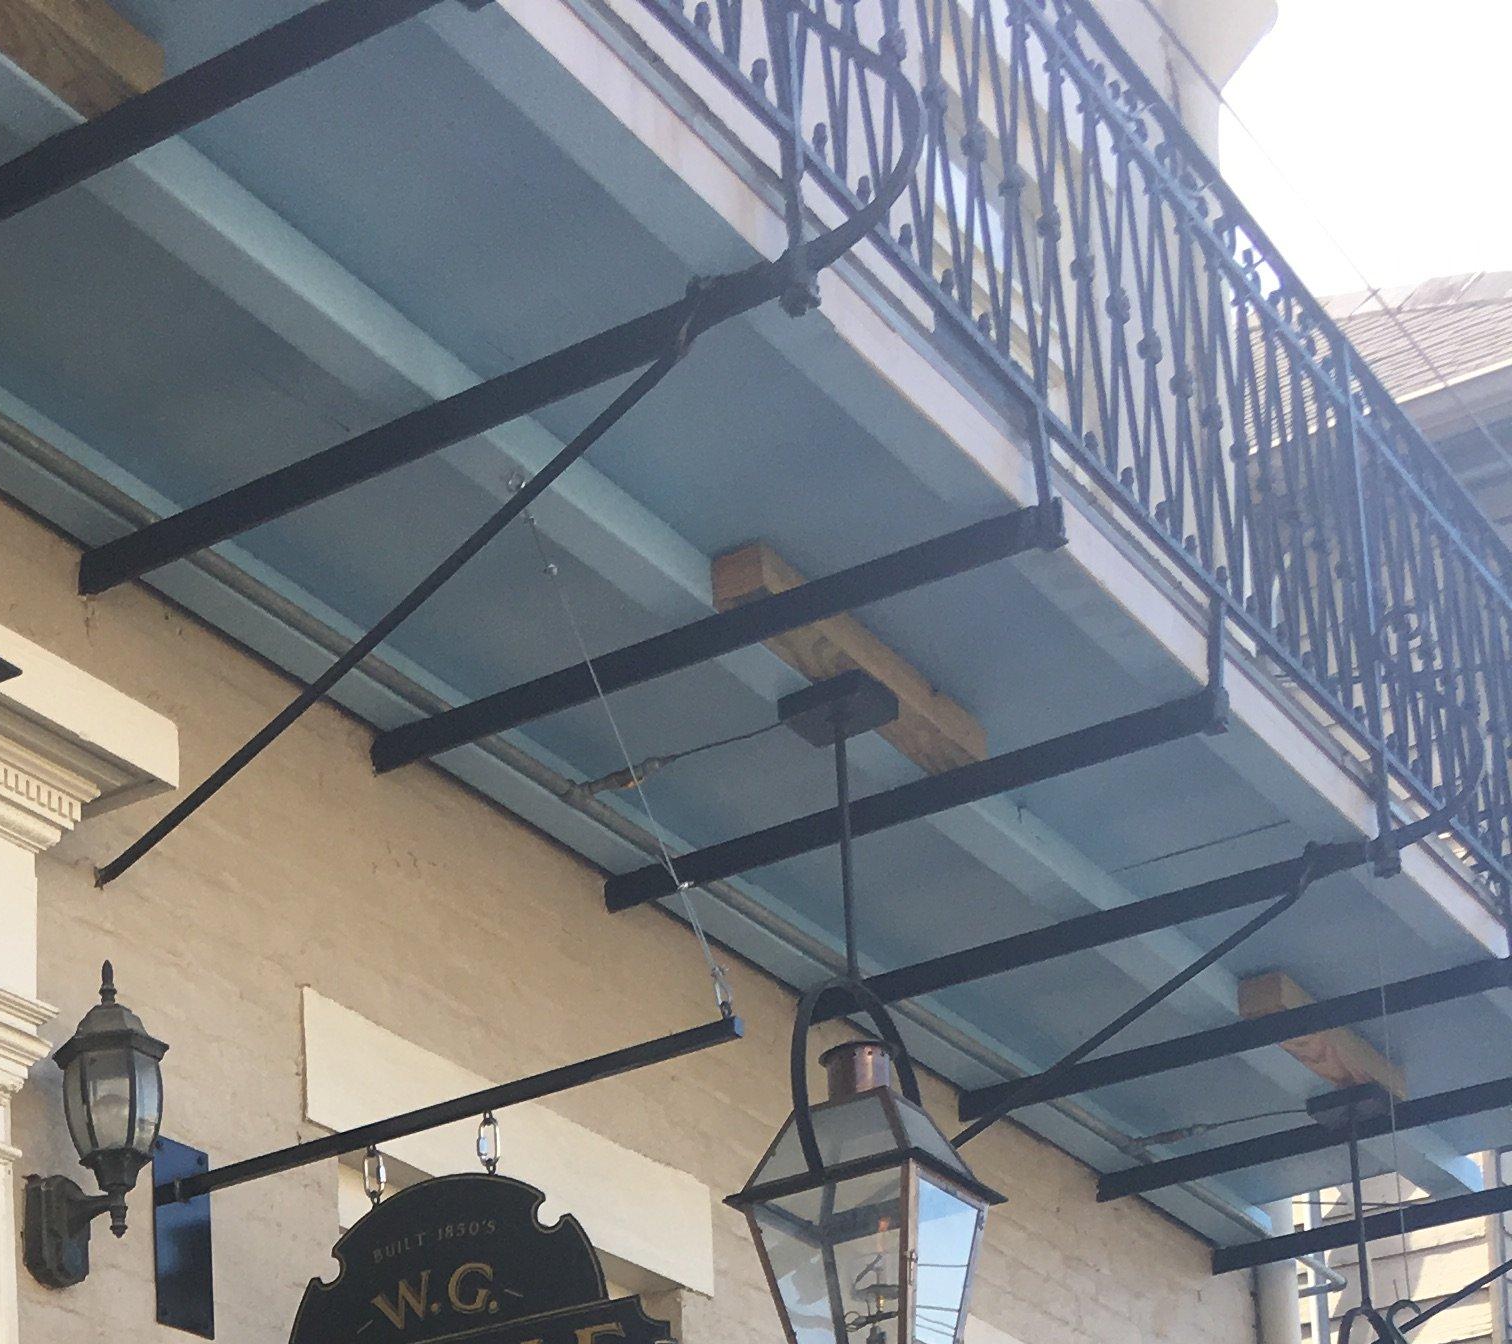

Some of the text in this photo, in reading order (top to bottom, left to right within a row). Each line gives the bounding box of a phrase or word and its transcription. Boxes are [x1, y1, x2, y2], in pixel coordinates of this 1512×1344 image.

[372, 1218, 497, 1264] BUILT 1850'S
[371, 1262, 499, 1331] W.G.
